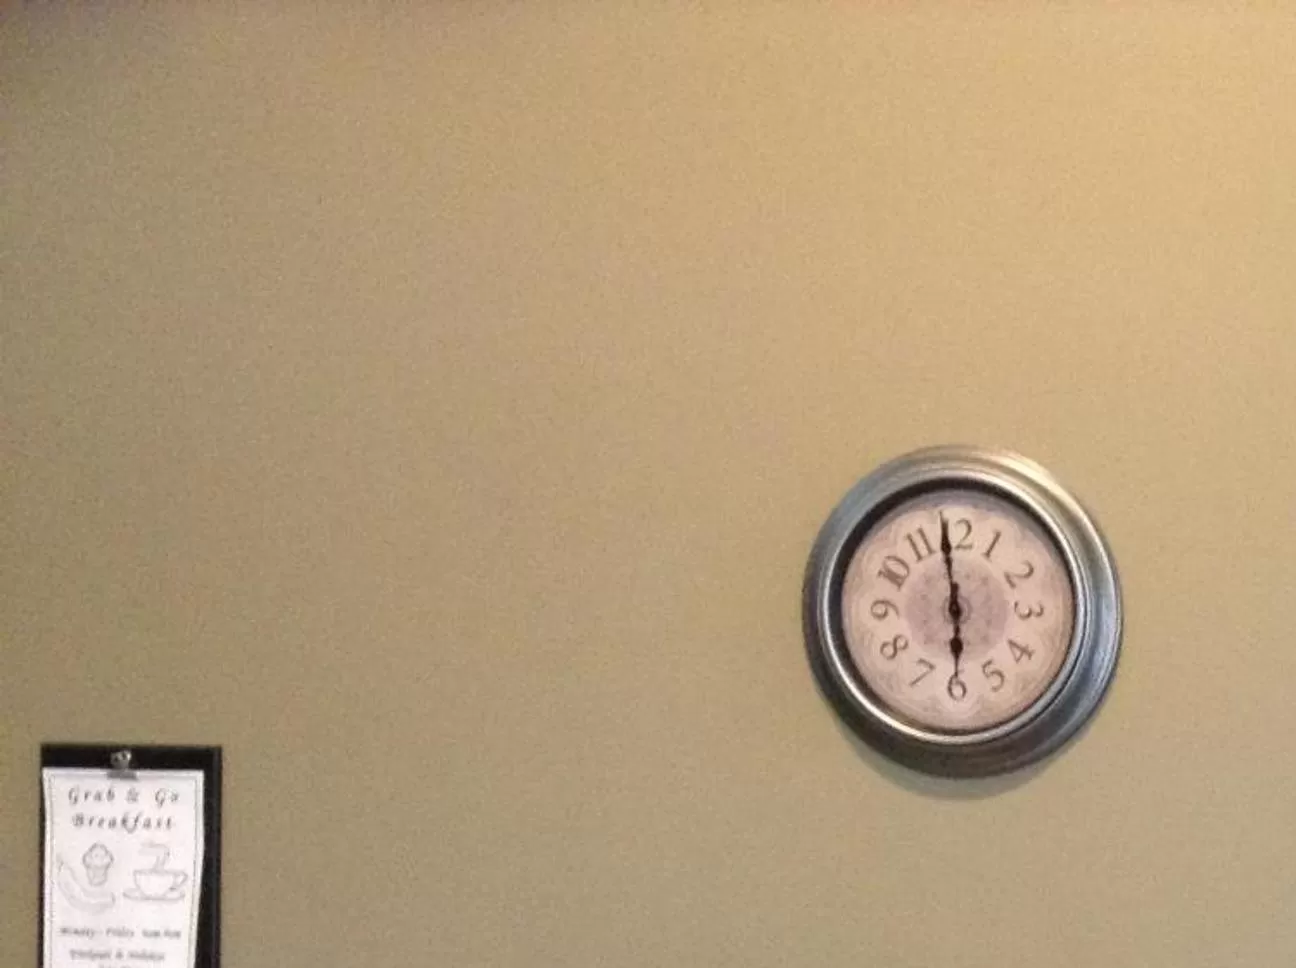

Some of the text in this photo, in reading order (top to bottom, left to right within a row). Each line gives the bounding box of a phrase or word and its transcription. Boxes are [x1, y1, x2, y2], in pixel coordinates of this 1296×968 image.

[906, 527, 935, 562] 11
[982, 530, 1002, 562] 1
[877, 555, 911, 592] 10
[1004, 560, 1034, 589] 2
[870, 599, 900, 622] 9
[1014, 601, 1044, 620] 3
[879, 634, 909, 661] 8
[1006, 638, 1035, 664] 4
[910, 658, 936, 688] 7
[947, 673, 968, 701] 6
[981, 660, 1005, 692] 5
[68, 785, 116, 805] Grab
[72, 812, 174, 834] Breakfast
